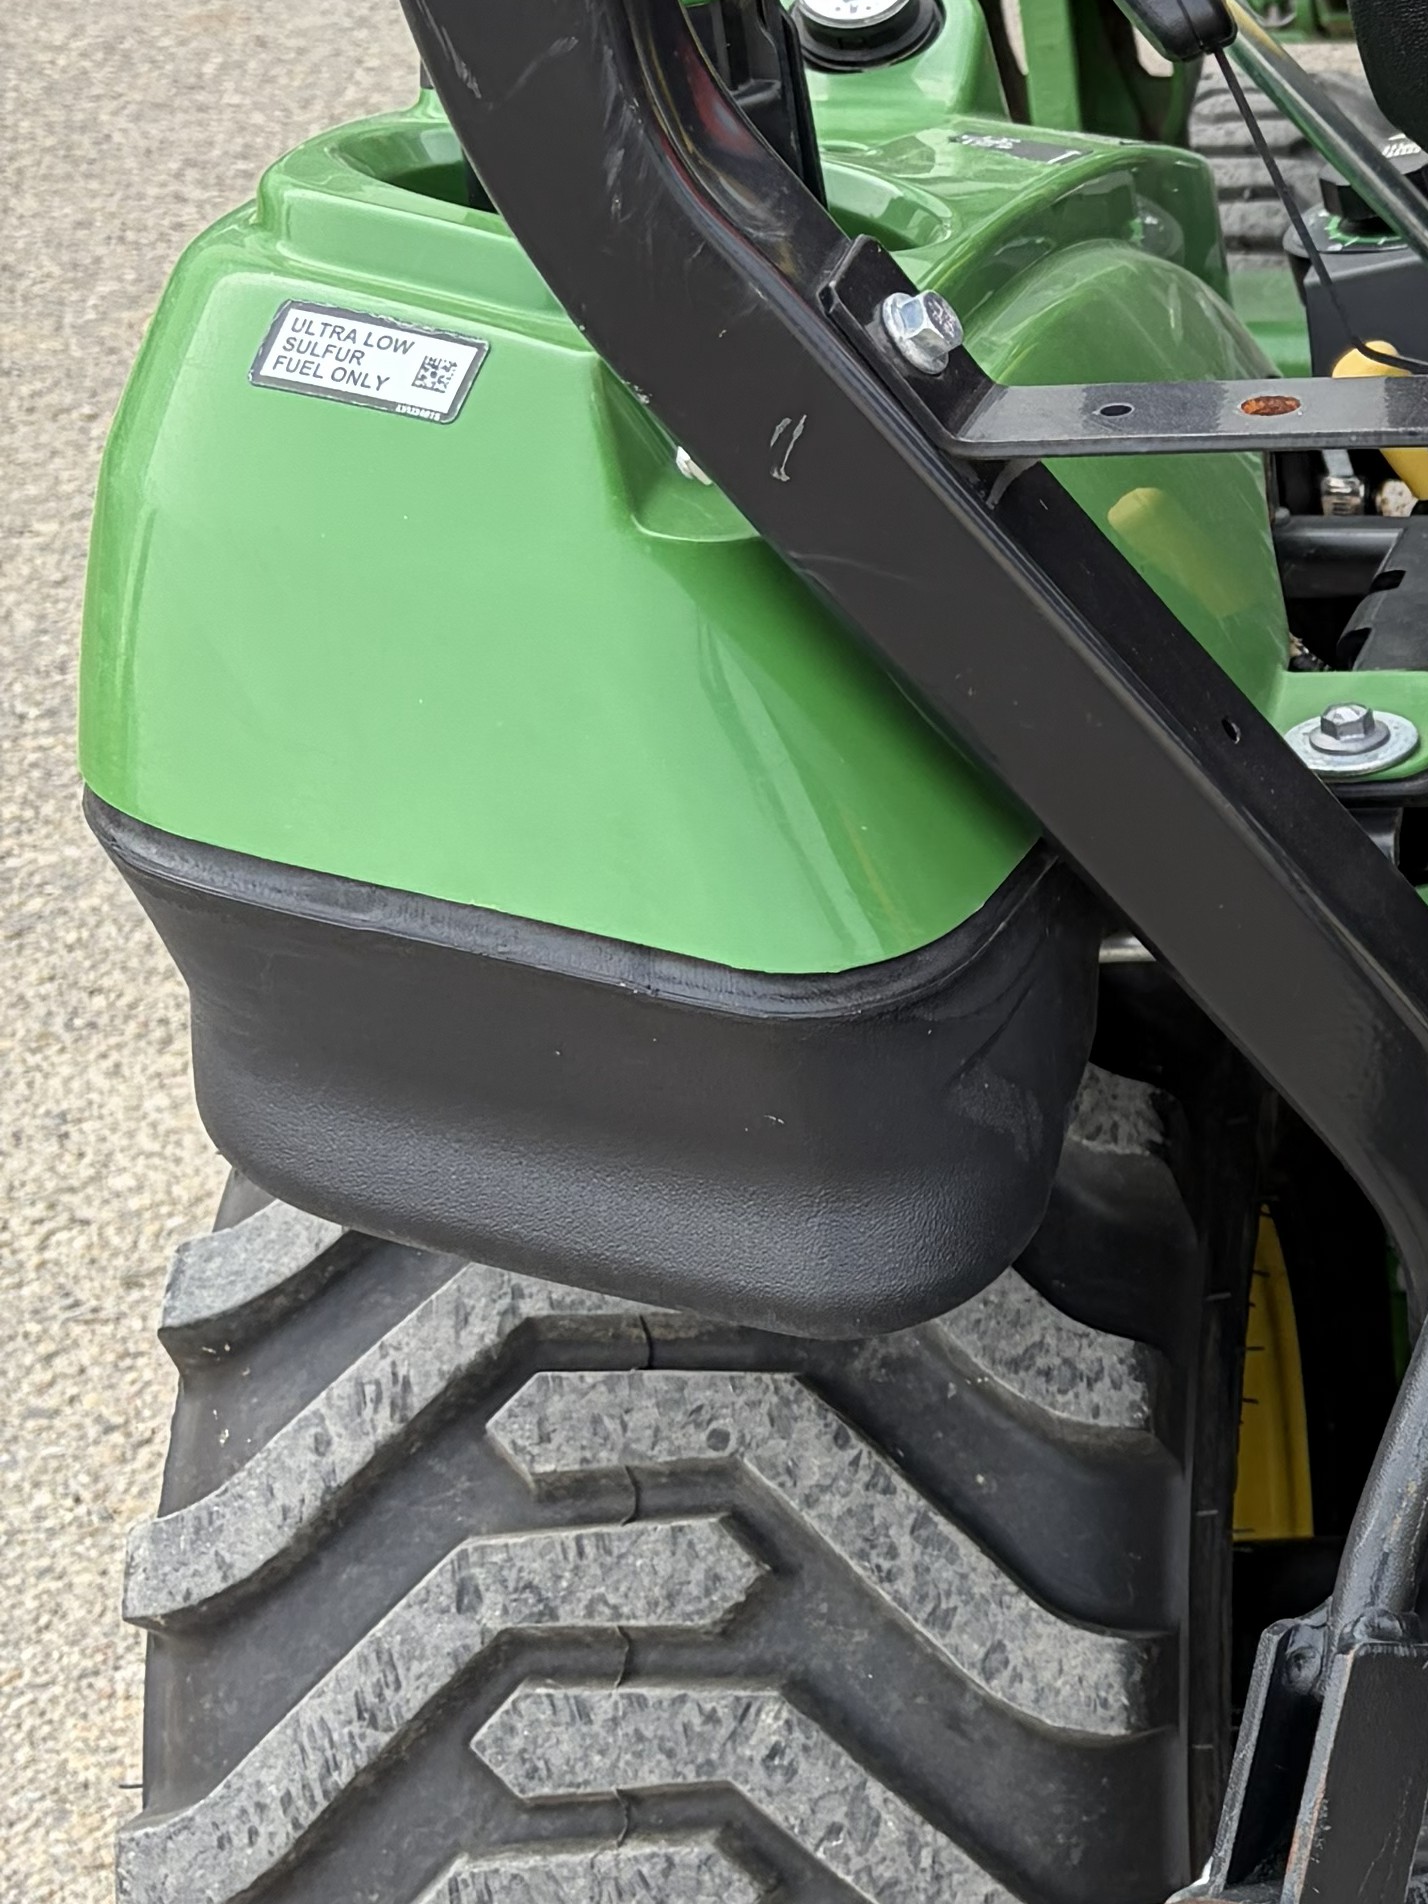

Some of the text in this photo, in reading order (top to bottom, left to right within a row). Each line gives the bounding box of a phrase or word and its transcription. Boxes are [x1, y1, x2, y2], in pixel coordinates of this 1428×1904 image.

[282, 337, 365, 366] SULFUR
[291, 317, 415, 355] ULTRA LOW
[272, 355, 390, 391] FUEL ONLY
